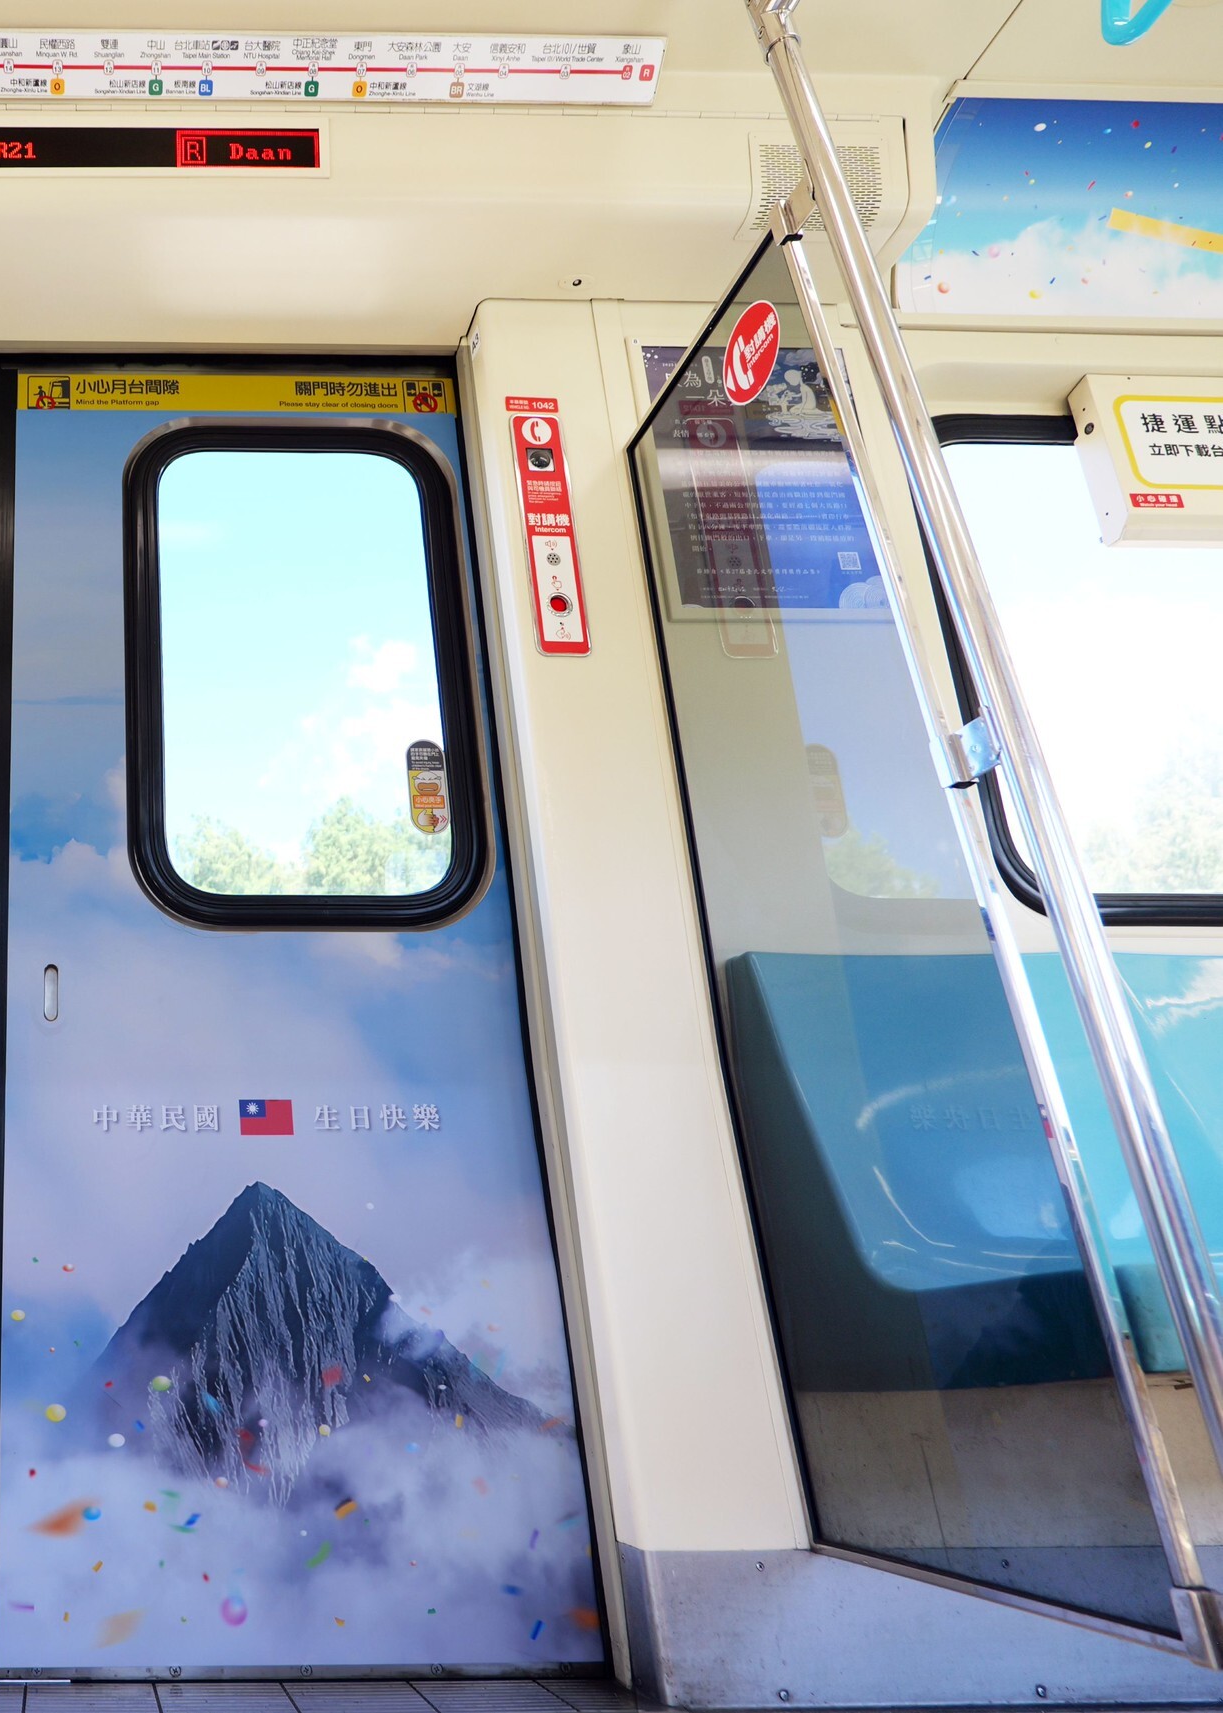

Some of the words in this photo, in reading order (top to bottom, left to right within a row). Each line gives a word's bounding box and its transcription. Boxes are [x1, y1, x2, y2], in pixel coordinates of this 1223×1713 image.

[147, 39, 165, 50] 中山
[354, 41, 373, 52] 東門
[387, 42, 442, 52] 大安森林公園
[453, 43, 472, 53] 大安
[94, 51, 125, 59] Shuanglian
[109, 79, 146, 88] 松山新店線
[265, 81, 302, 89] 松山新店線
[229, 143, 292, 160] Daan
[76, 379, 180, 395] 小心月台間隙
[295, 381, 397, 397] 關門時勿進出
[527, 513, 570, 526] 對講機
[93, 1104, 220, 1132] 中華民國
[314, 1104, 441, 1131] 生日快樂
